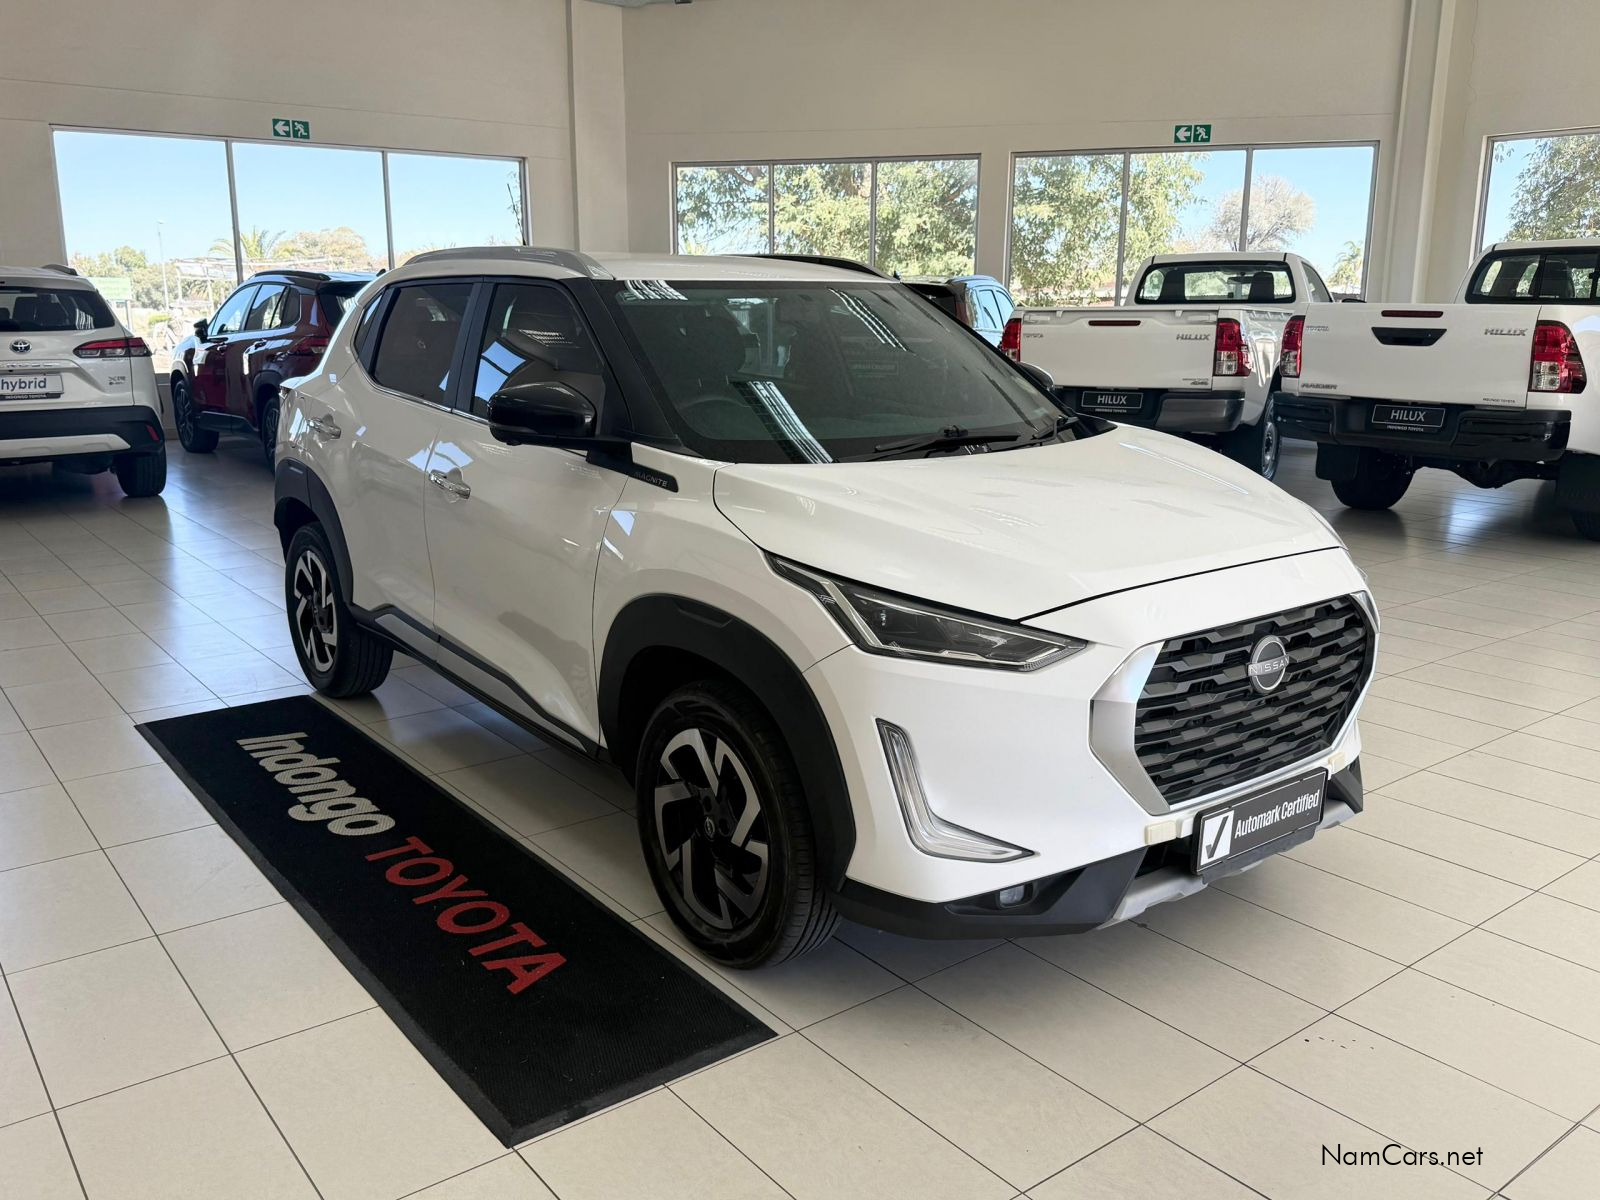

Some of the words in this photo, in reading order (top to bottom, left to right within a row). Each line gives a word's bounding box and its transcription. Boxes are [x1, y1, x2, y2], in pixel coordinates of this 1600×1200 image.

[1484, 328, 1528, 336] HILUX
[1, 377, 47, 391] hybrid
[1097, 395, 1127, 404] HILUX
[1390, 409, 1426, 422] HILUX
[1248, 655, 1290, 675] NISSAN
[1234, 804, 1281, 839] Automark
[1281, 789, 1320, 820] Certified
[236, 731, 396, 836] Indongo
[364, 836, 567, 995] TOYOTA
